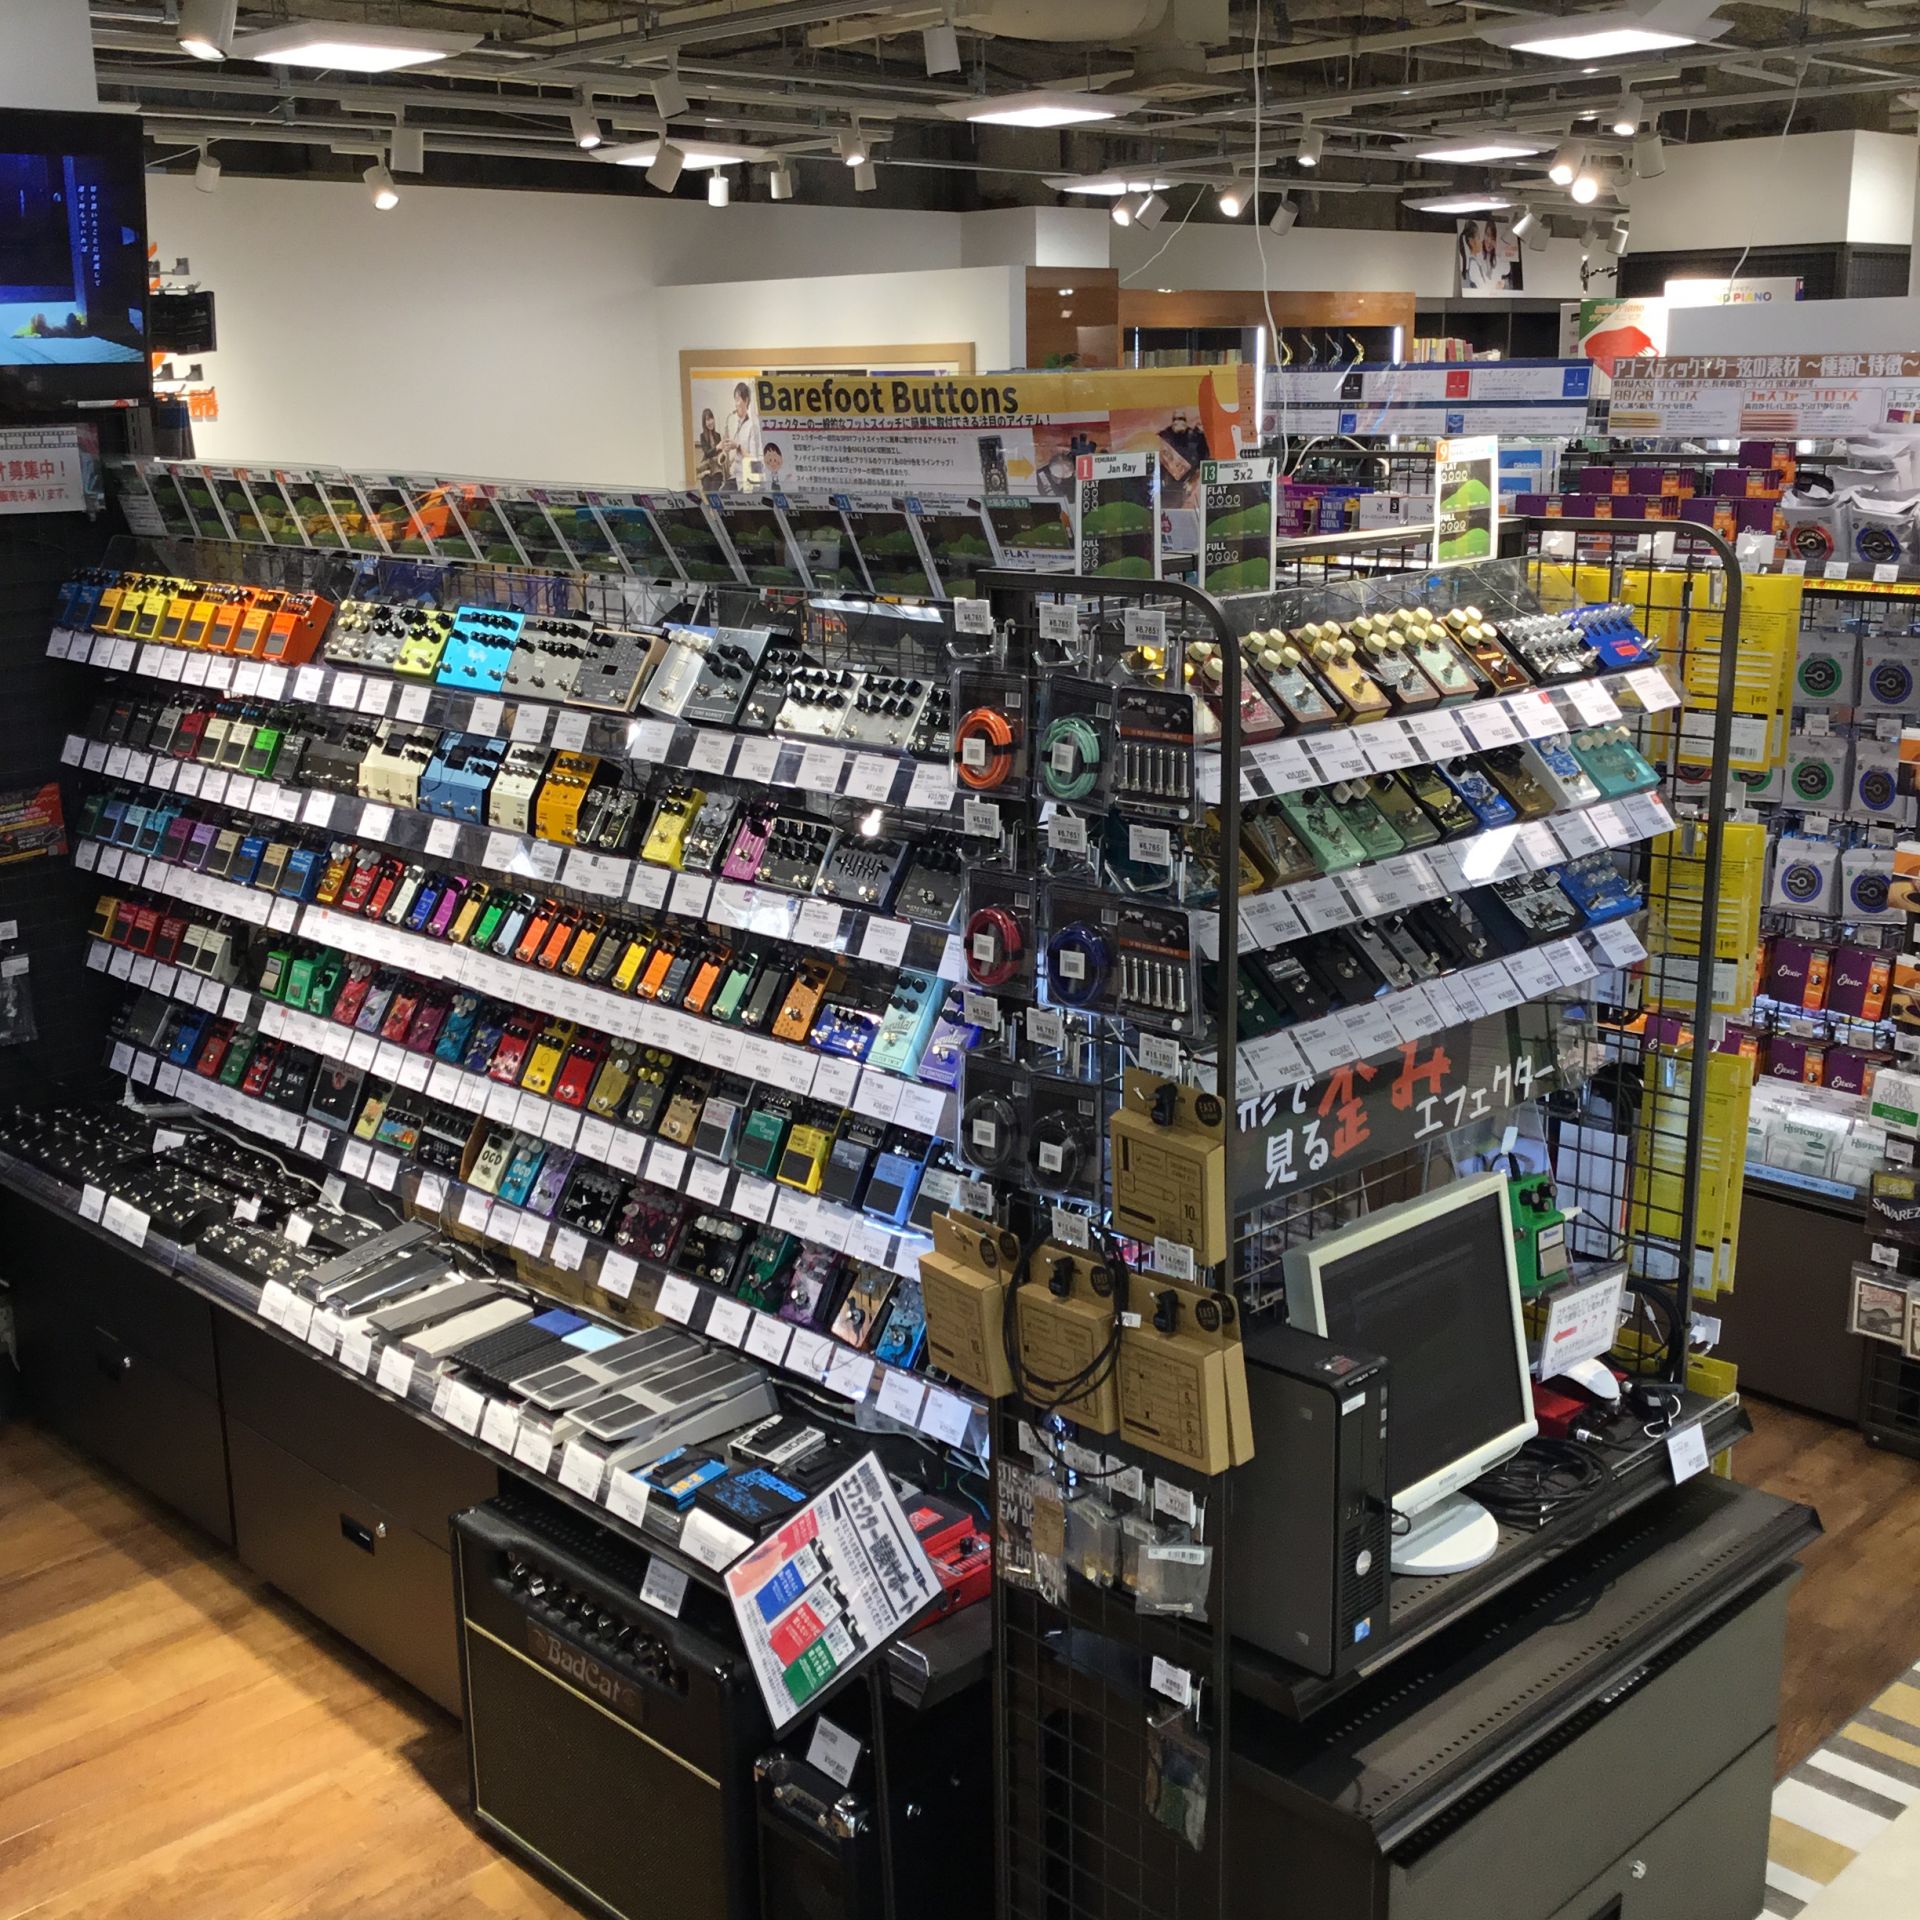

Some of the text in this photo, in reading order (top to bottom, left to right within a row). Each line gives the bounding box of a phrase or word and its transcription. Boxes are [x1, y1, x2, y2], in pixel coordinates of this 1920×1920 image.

[758, 380, 1019, 415] Barefoot Buttons
[0, 459, 66, 482] 募集中！
[1107, 463, 1137, 475] Jan Ray
[1203, 468, 1216, 481] 13
[1207, 486, 1228, 495] FLAT
[1082, 540, 1100, 548] FULL
[1206, 543, 1226, 552] FULL
[1003, 549, 1030, 560] FLAT
[1778, 965, 1803, 979] Elixir
[1837, 973, 1863, 988] Elixir
[1773, 1062, 1799, 1076] Elixir
[286, 1072, 304, 1086] RAT
[1831, 1075, 1857, 1090] Elixir
[1318, 1040, 1453, 1160] 歪み
[1413, 1055, 1557, 1140] エフェクター
[481, 1148, 503, 1166] OCD
[1264, 1118, 1330, 1190] 見る
[546, 1635, 621, 1703] BadCat
